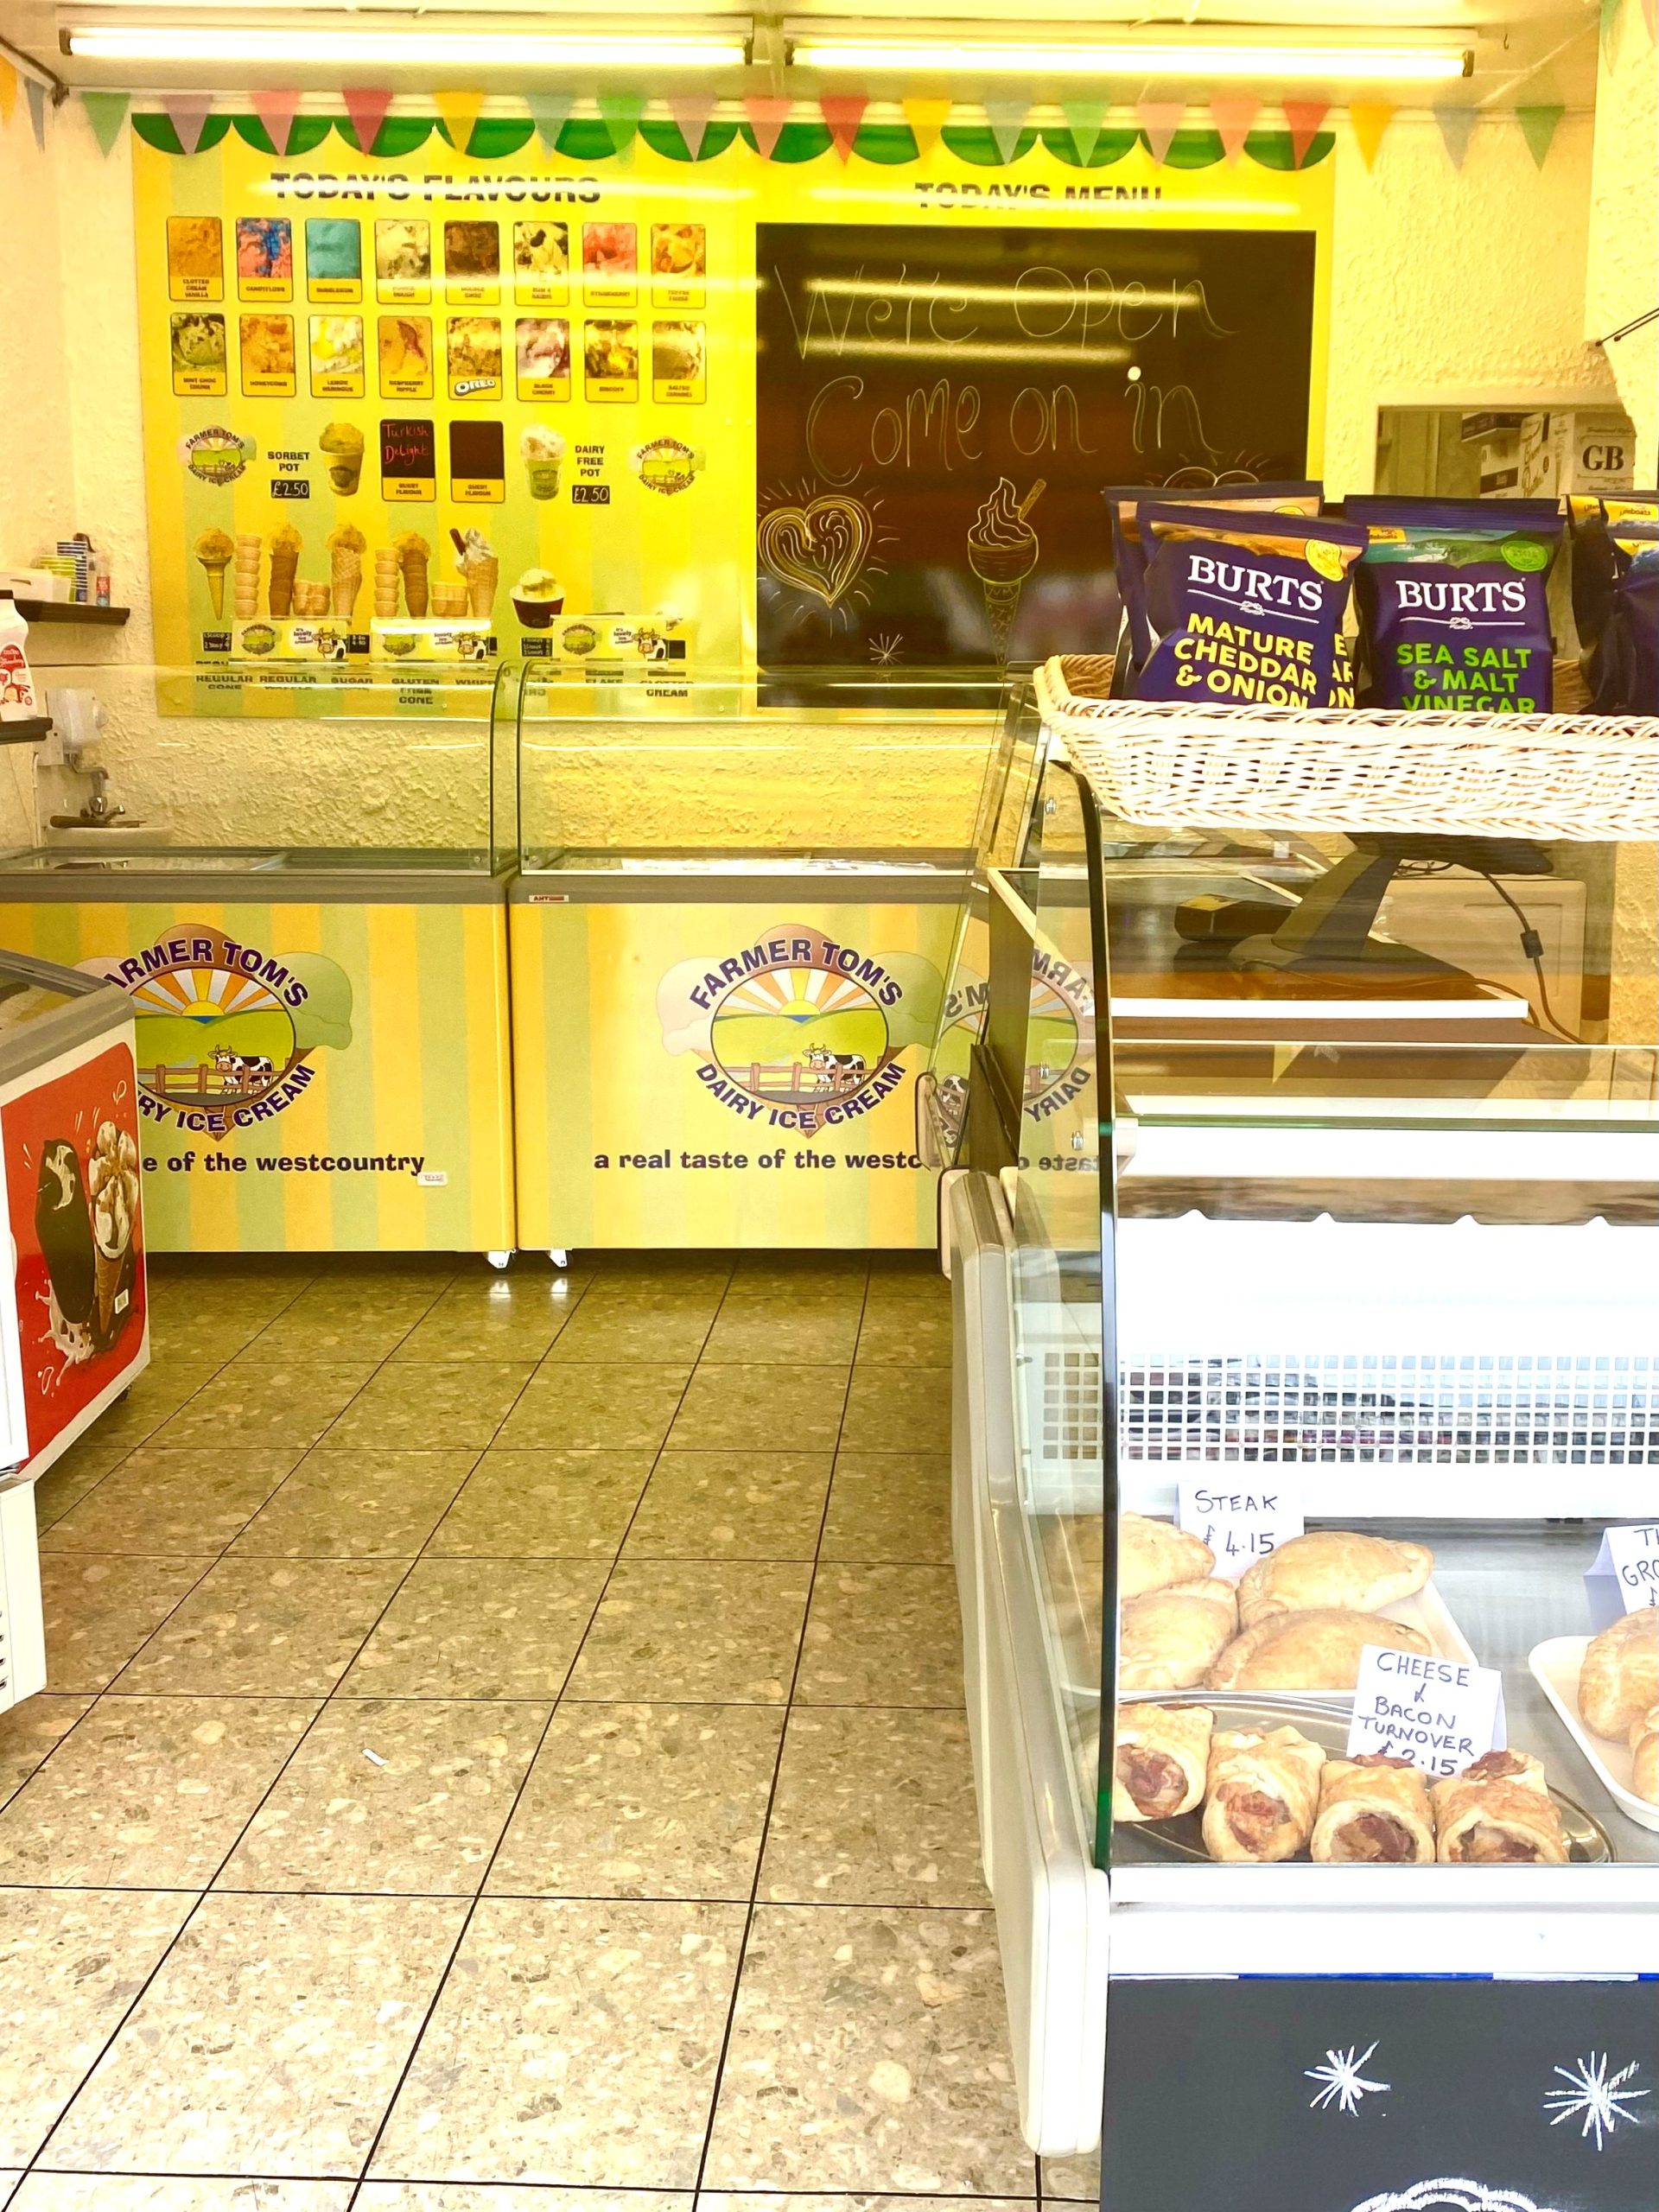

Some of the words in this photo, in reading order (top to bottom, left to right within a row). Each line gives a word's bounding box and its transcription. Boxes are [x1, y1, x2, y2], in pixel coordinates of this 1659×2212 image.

[270, 172, 410, 200] TODAY'S
[423, 174, 601, 203] FLAVOURS
[914, 181, 1052, 210] TODAY'S
[454, 378, 497, 397] OREO
[184, 429, 219, 450] FARMER
[221, 429, 246, 450] TOM'S
[382, 423, 429, 439] Turkish
[267, 451, 310, 461] SORBET
[575, 445, 605, 454] DAIRY
[576, 457, 604, 466] FREE
[636, 438, 671, 460] FARMER
[1582, 444, 1624, 471] GB
[187, 463, 207, 482] DAIRY
[223, 461, 247, 484] CREAM
[278, 463, 300, 472] POT
[580, 468, 601, 477] POT
[638, 474, 657, 493] DAIRY
[1186, 554, 1324, 612] BURTS
[1395, 578, 1527, 613] BURTS
[1186, 612, 1315, 666] MATURE
[1173, 637, 1318, 696] CHEDDAR
[1396, 643, 1455, 666] SEA
[1463, 647, 1532, 670] SALT
[195, 675, 253, 683] REGULAR
[259, 675, 317, 683] REGULAR
[1175, 664, 1203, 687] &
[1206, 668, 1309, 709] ONION
[1414, 669, 1437, 690] &
[1441, 669, 1520, 693] MALT
[645, 689, 689, 697] CREAM
[1401, 693, 1536, 715] VINEGAR
[104, 938, 213, 989] RMER
[222, 940, 309, 1007] TOM'S
[689, 938, 812, 1010] FARMER
[821, 941, 904, 1007] TOM'S
[176, 1110, 226, 1132] ICE
[233, 1064, 316, 1128] CREAM
[695, 1063, 765, 1122] DAIRY
[768, 1109, 817, 1129] ICE
[824, 1062, 906, 1125] CREAM
[168, 1151, 196, 1172] of
[204, 1152, 247, 1172] the
[255, 1153, 424, 1177] westcountry
[594, 1153, 610, 1169] a
[619, 1148, 671, 1169] real
[680, 1150, 749, 1169] taste
[758, 1148, 786, 1169] of
[794, 1149, 836, 1169] the
[1194, 1490, 1278, 1514] STEAK
[1376, 1651, 1470, 1687] CHEESE
[1375, 1695, 1456, 1729] BACON
[1357, 1715, 1475, 1757] TURNOVER
